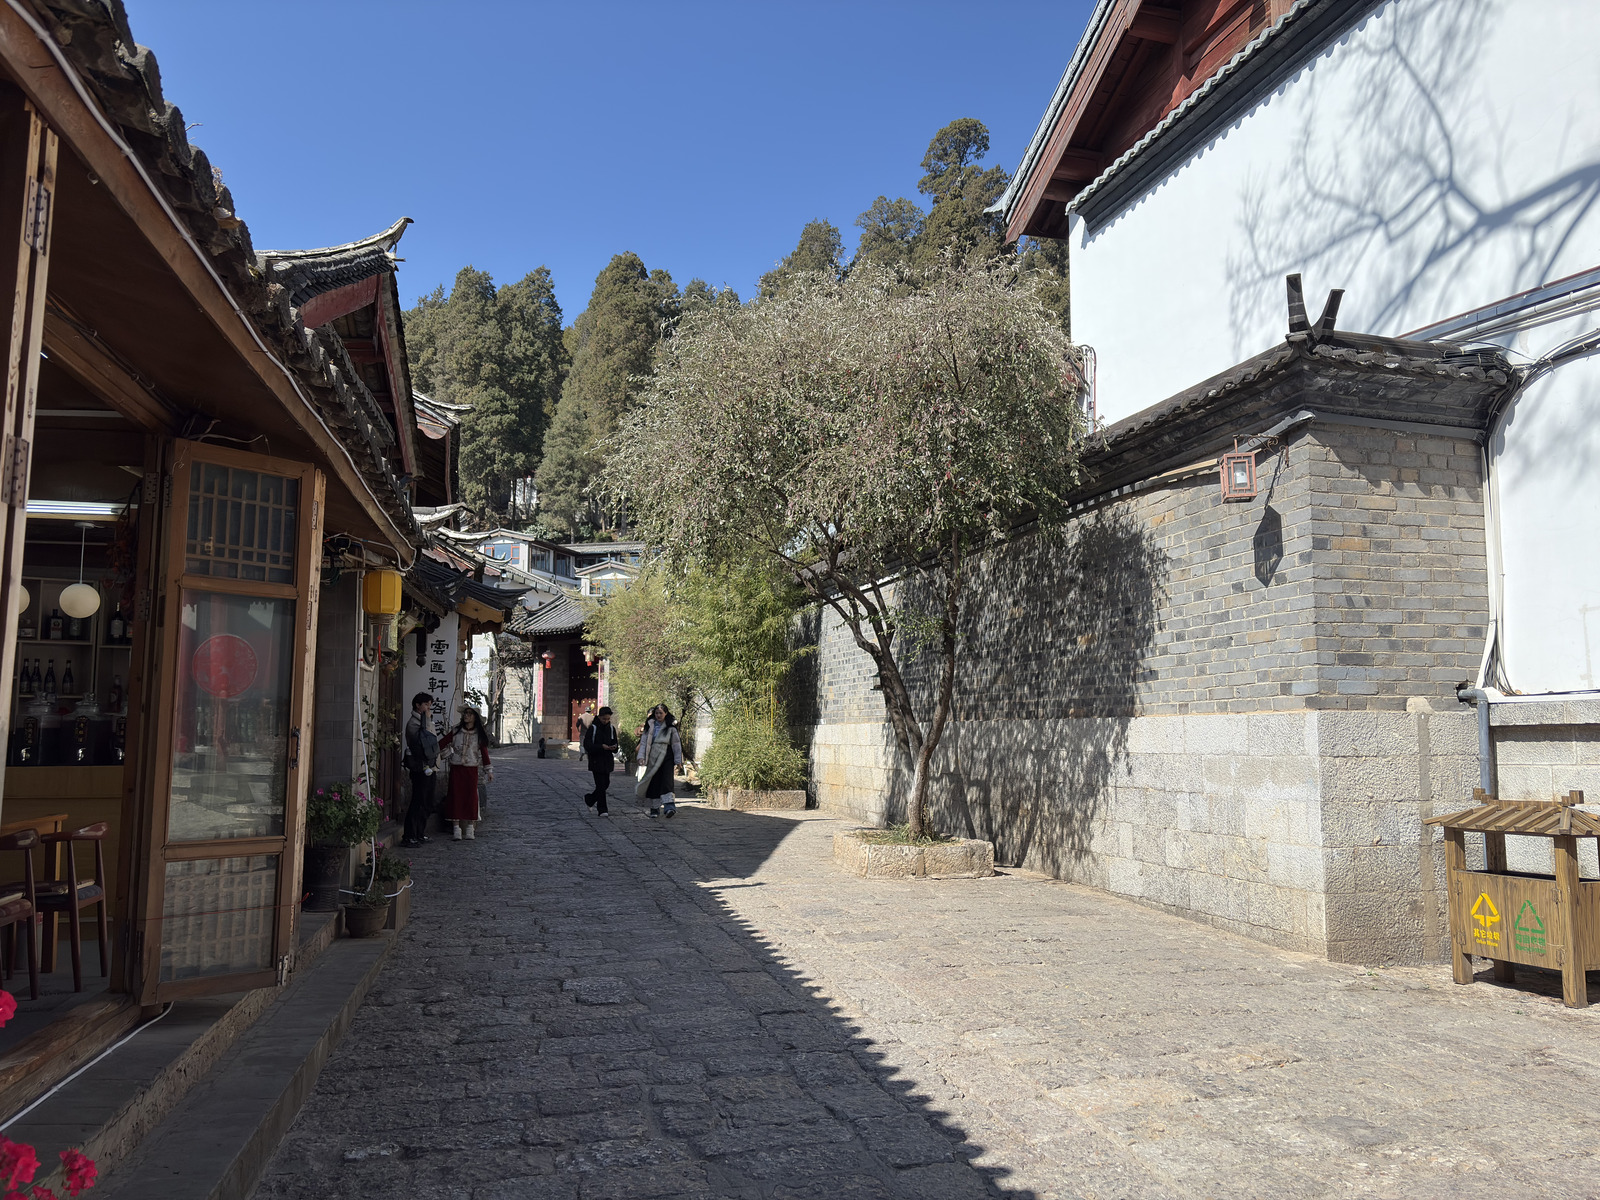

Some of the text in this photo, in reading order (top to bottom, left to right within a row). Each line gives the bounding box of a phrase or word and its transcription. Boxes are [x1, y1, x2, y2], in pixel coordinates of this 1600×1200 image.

[1473, 928, 1500, 941] 其它垃圾
[1515, 934, 1546, 946] 可回收物
